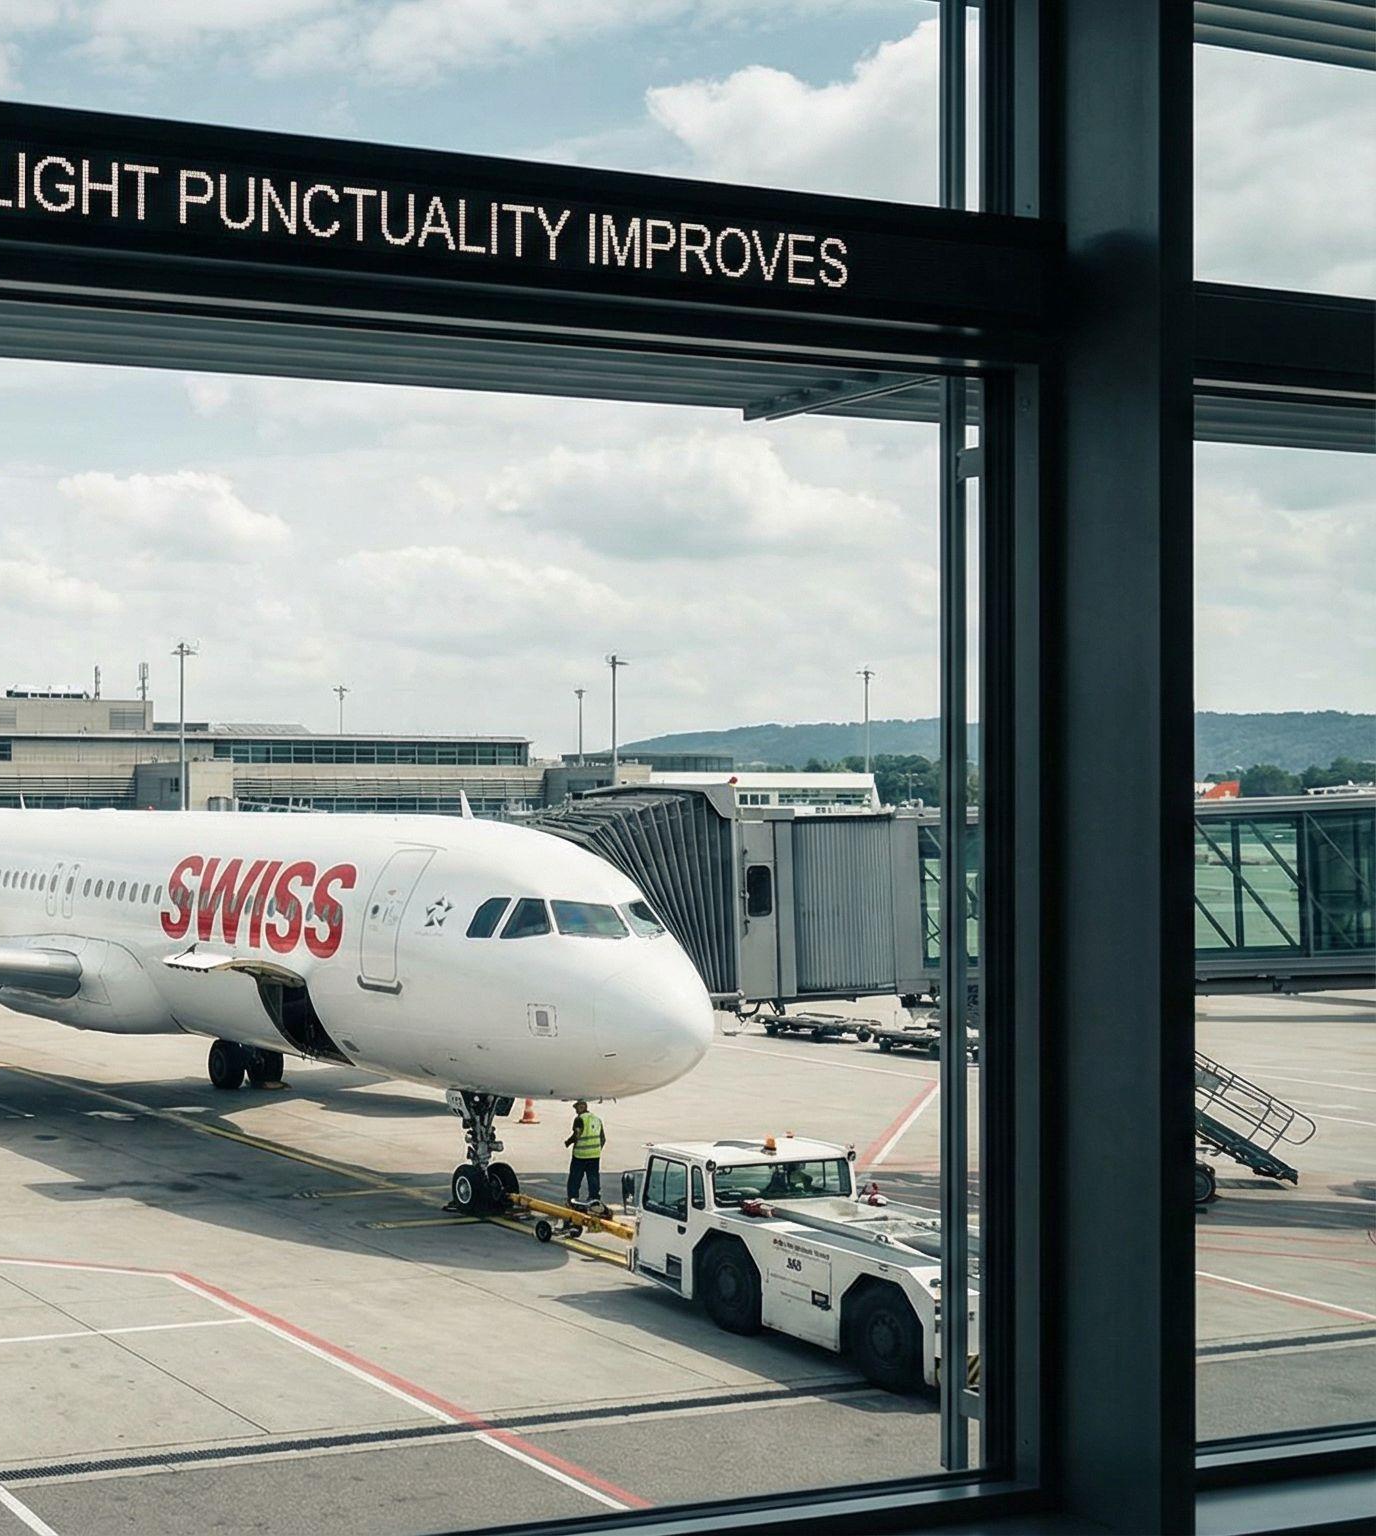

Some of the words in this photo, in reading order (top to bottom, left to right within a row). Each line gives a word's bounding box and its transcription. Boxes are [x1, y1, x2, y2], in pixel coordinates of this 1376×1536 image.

[180, 170, 570, 260] PUNCTUALITY
[589, 214, 847, 287] IMPROVES
[160, 855, 357, 959] SWISS
